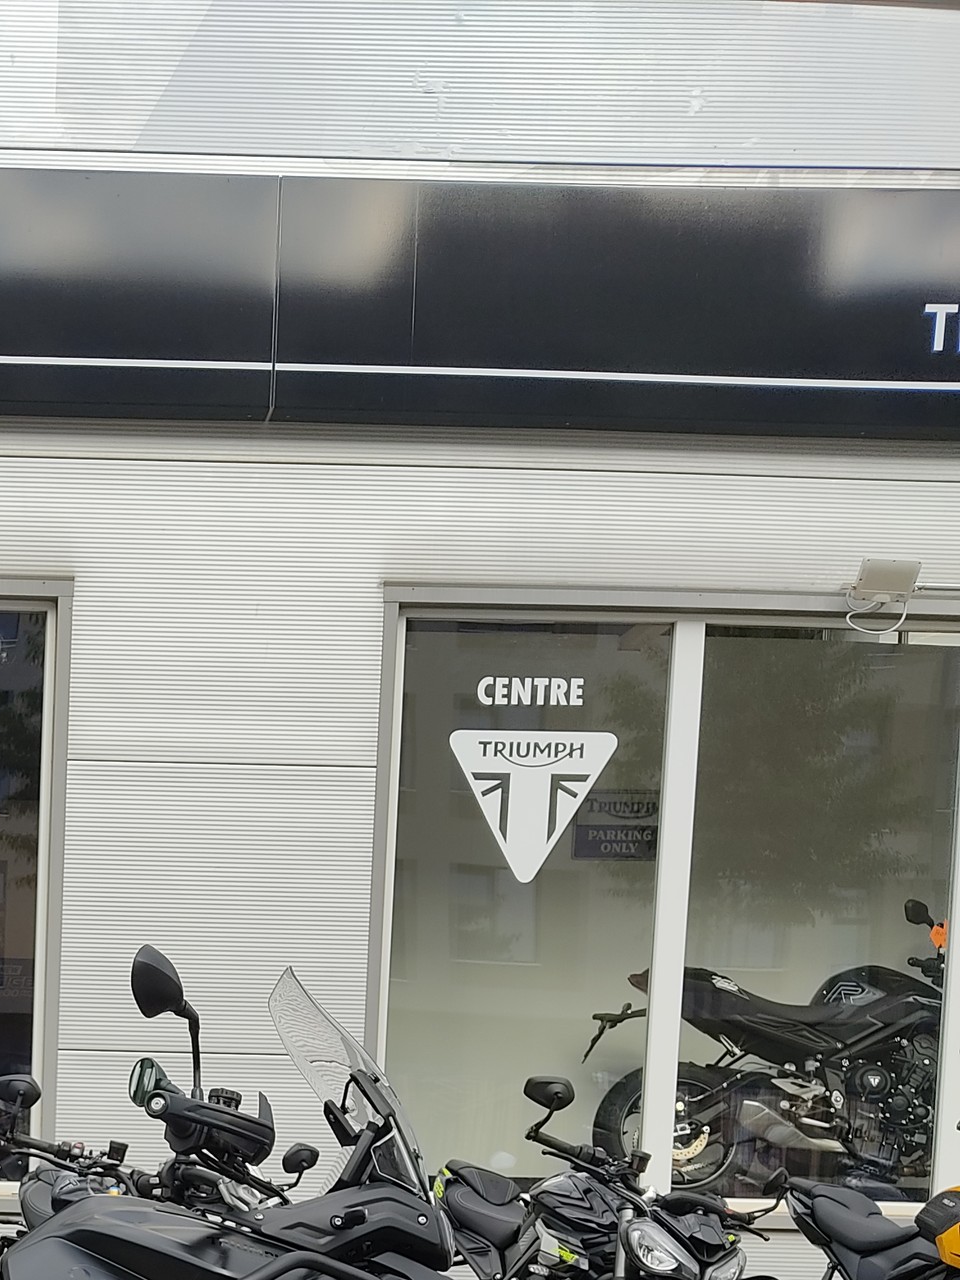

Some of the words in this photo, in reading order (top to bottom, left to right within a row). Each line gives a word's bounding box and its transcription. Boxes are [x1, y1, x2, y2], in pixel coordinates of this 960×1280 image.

[925, 303, 960, 352] T
[477, 676, 584, 706] CENTRE
[478, 741, 584, 764] TRIUMPH
[586, 798, 658, 816] TRIUMPH
[588, 829, 652, 841] PARKING
[601, 842, 638, 853] ONLY
